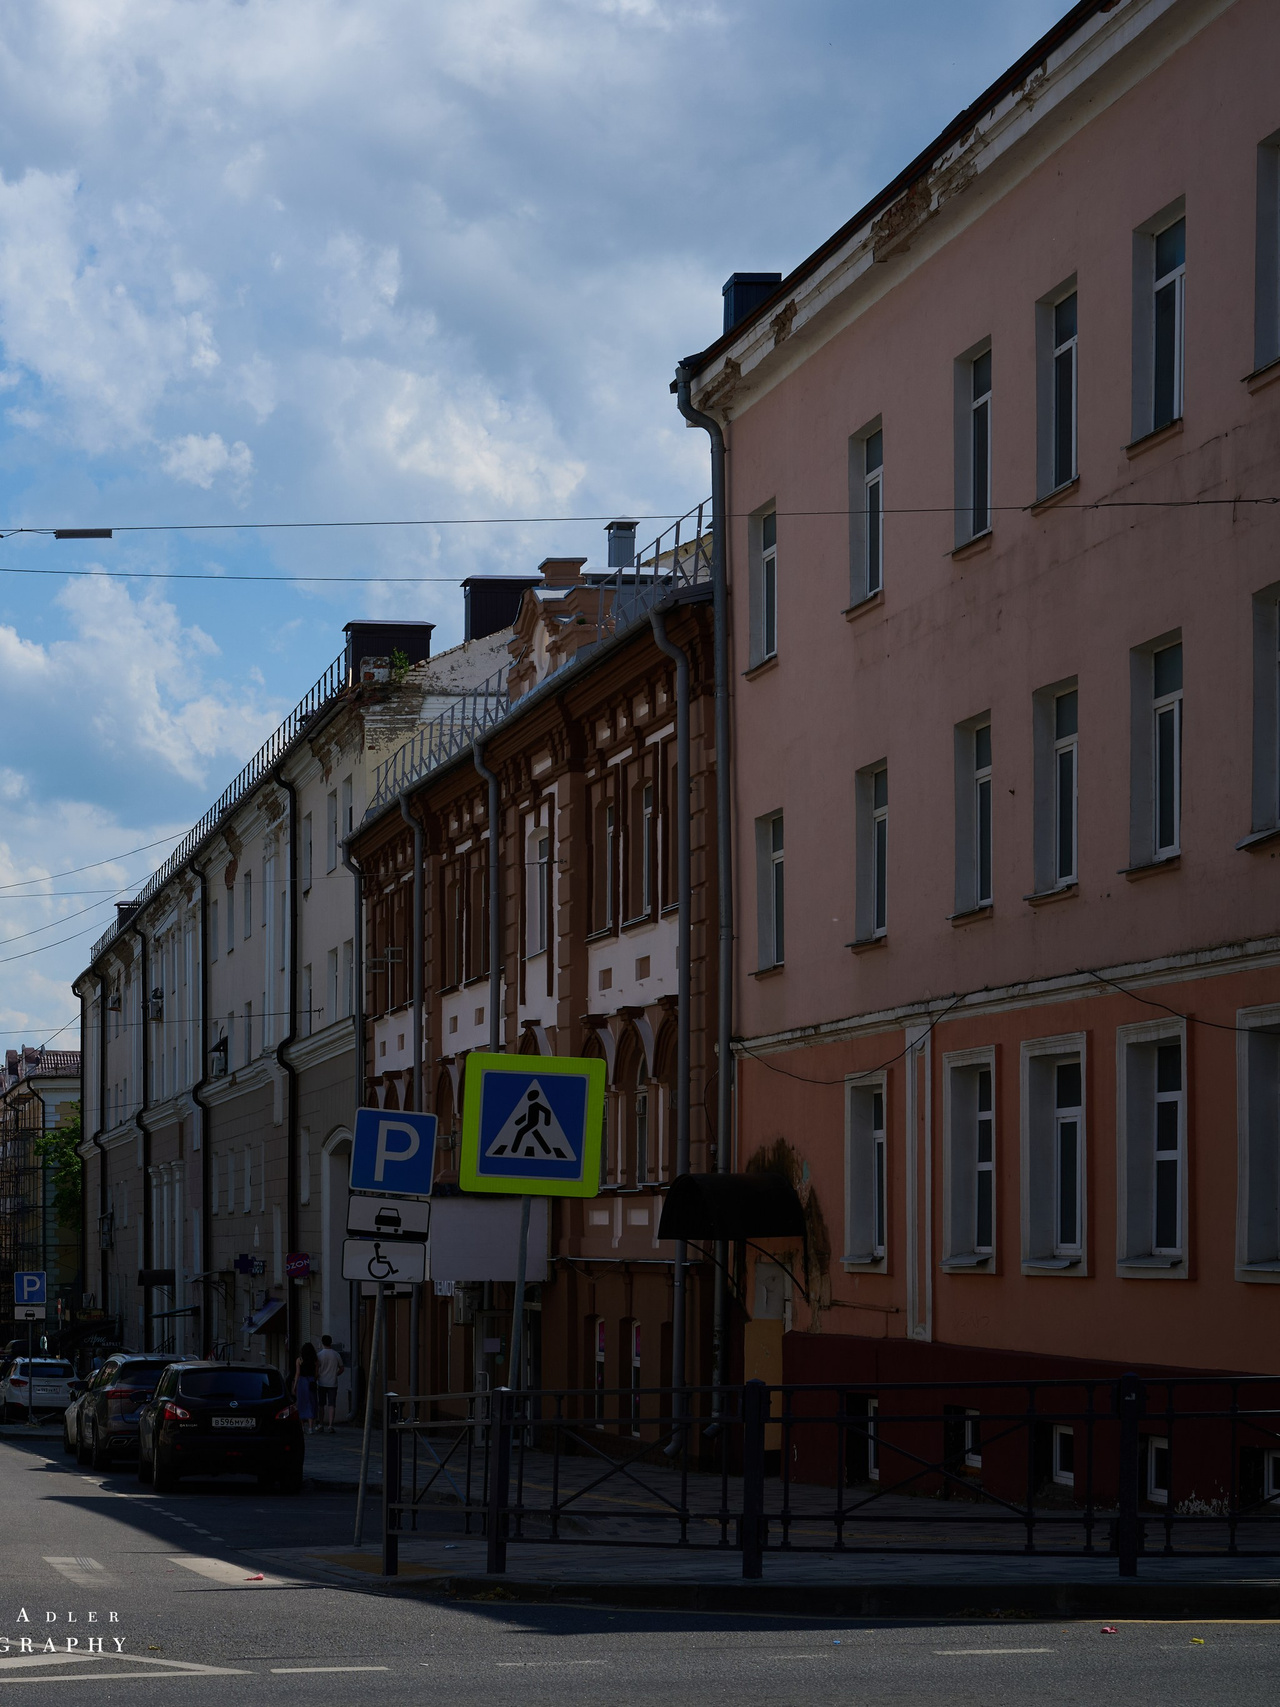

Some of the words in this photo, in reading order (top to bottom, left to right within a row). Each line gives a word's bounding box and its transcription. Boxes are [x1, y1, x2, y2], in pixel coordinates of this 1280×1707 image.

[373, 1119, 421, 1183] P
[286, 1258, 310, 1271] OZON
[23, 1275, 41, 1300] P
